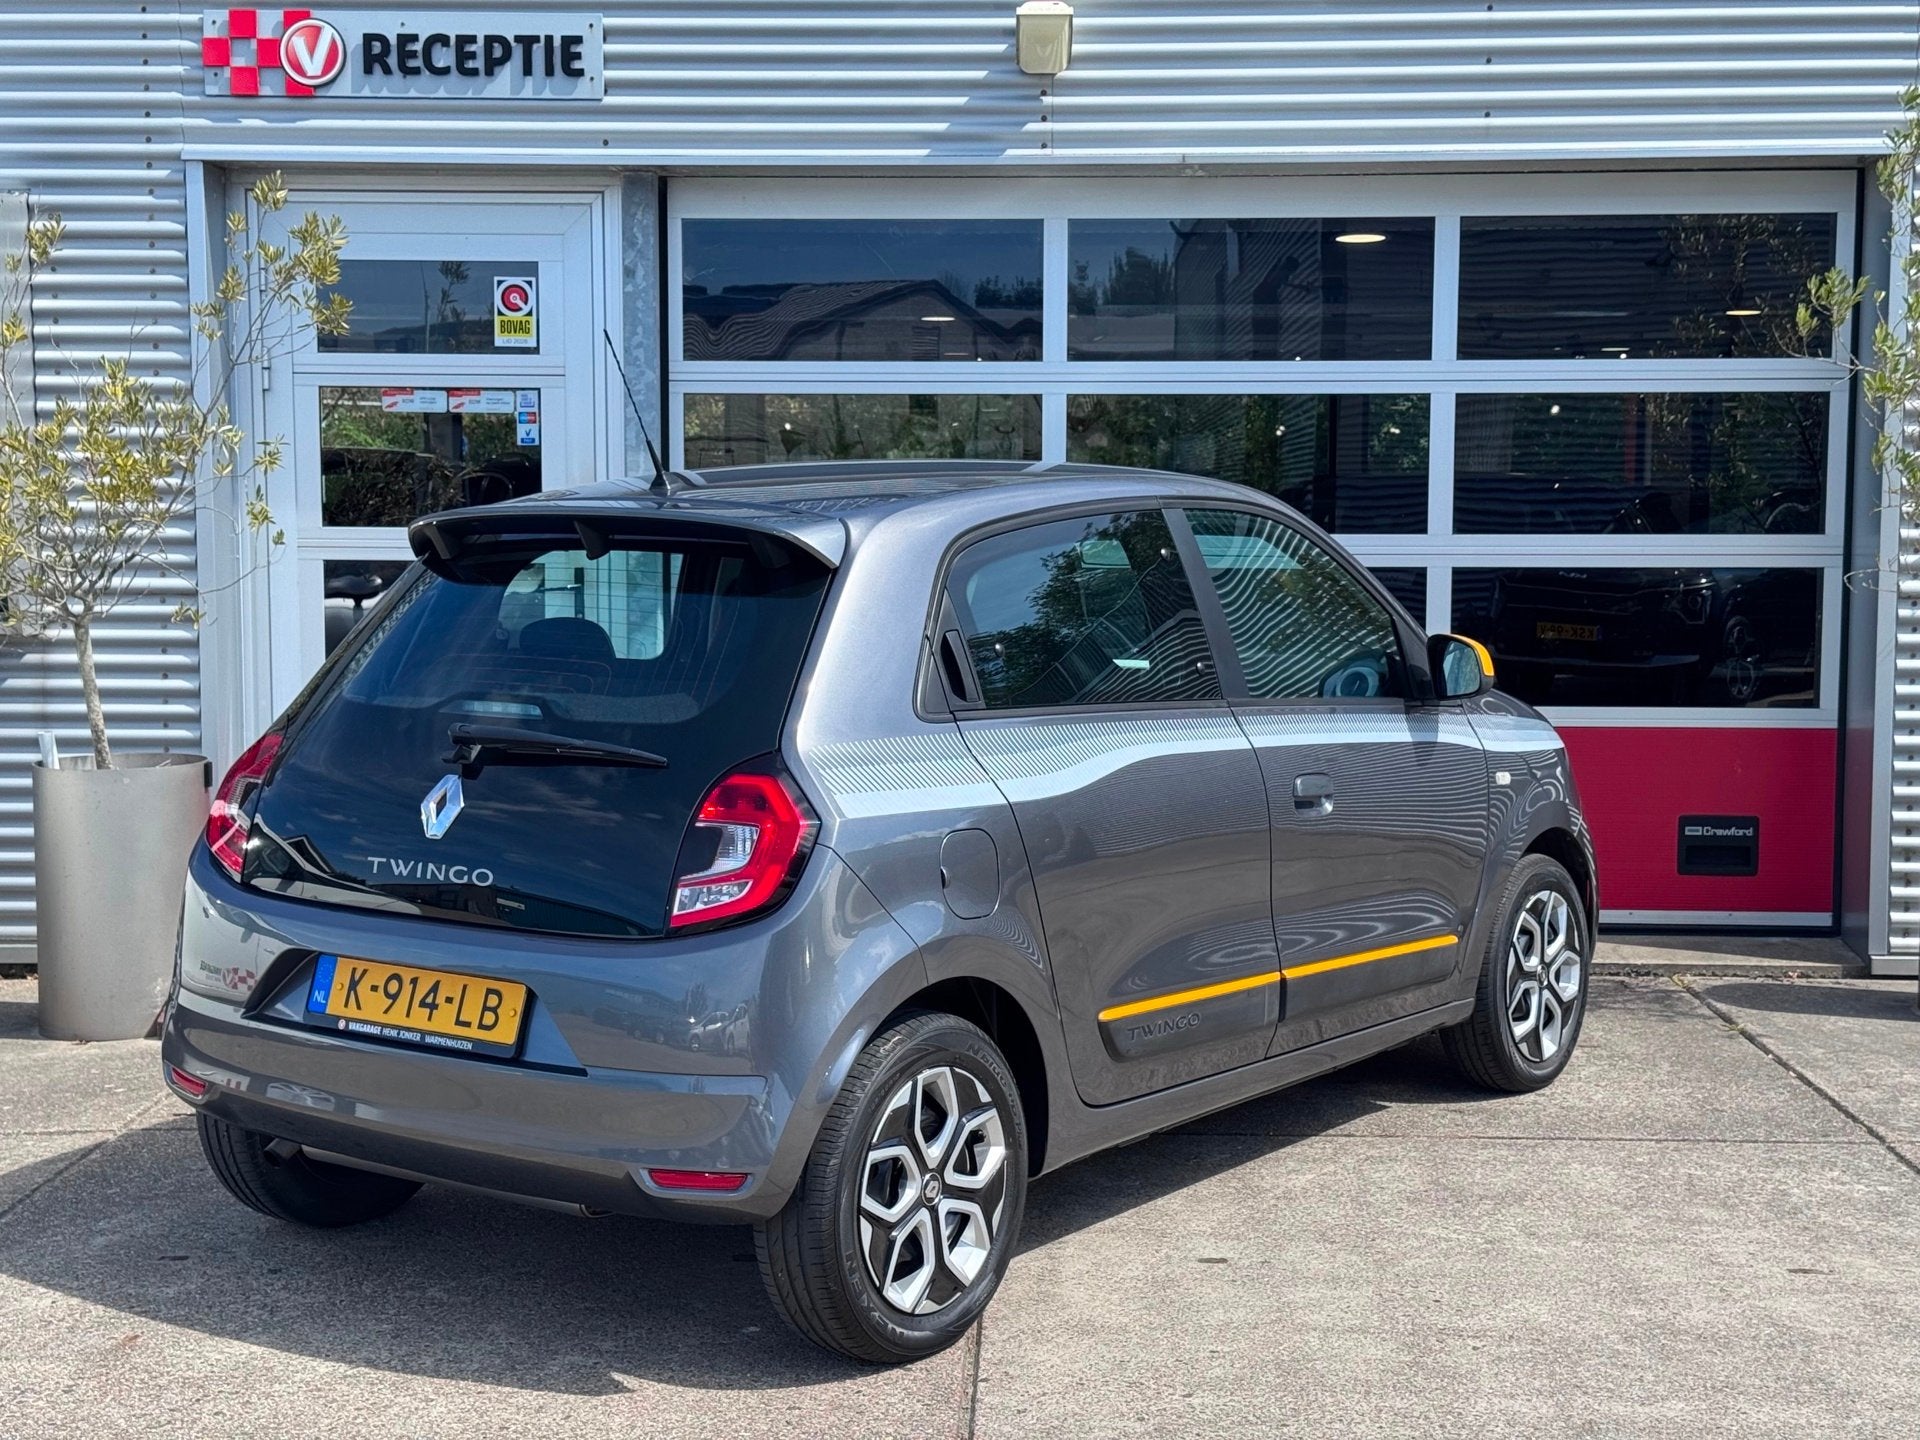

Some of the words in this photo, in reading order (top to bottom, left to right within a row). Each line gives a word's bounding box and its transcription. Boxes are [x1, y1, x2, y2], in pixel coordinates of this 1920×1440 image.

[362, 33, 585, 77] RECEPTIE
[500, 319, 531, 335] BOVAG
[1703, 826, 1754, 836] Crawford
[367, 856, 494, 887] TWINGO
[313, 989, 326, 1003] NL
[343, 967, 503, 1032] K-914-LB
[348, 1020, 383, 1036] VAKGARAGE
[382, 1027, 399, 1038] HENK
[398, 1030, 421, 1042] JONKER
[424, 1034, 473, 1051] WARMENHUIZEN
[1127, 1012, 1201, 1041] TWINGO
